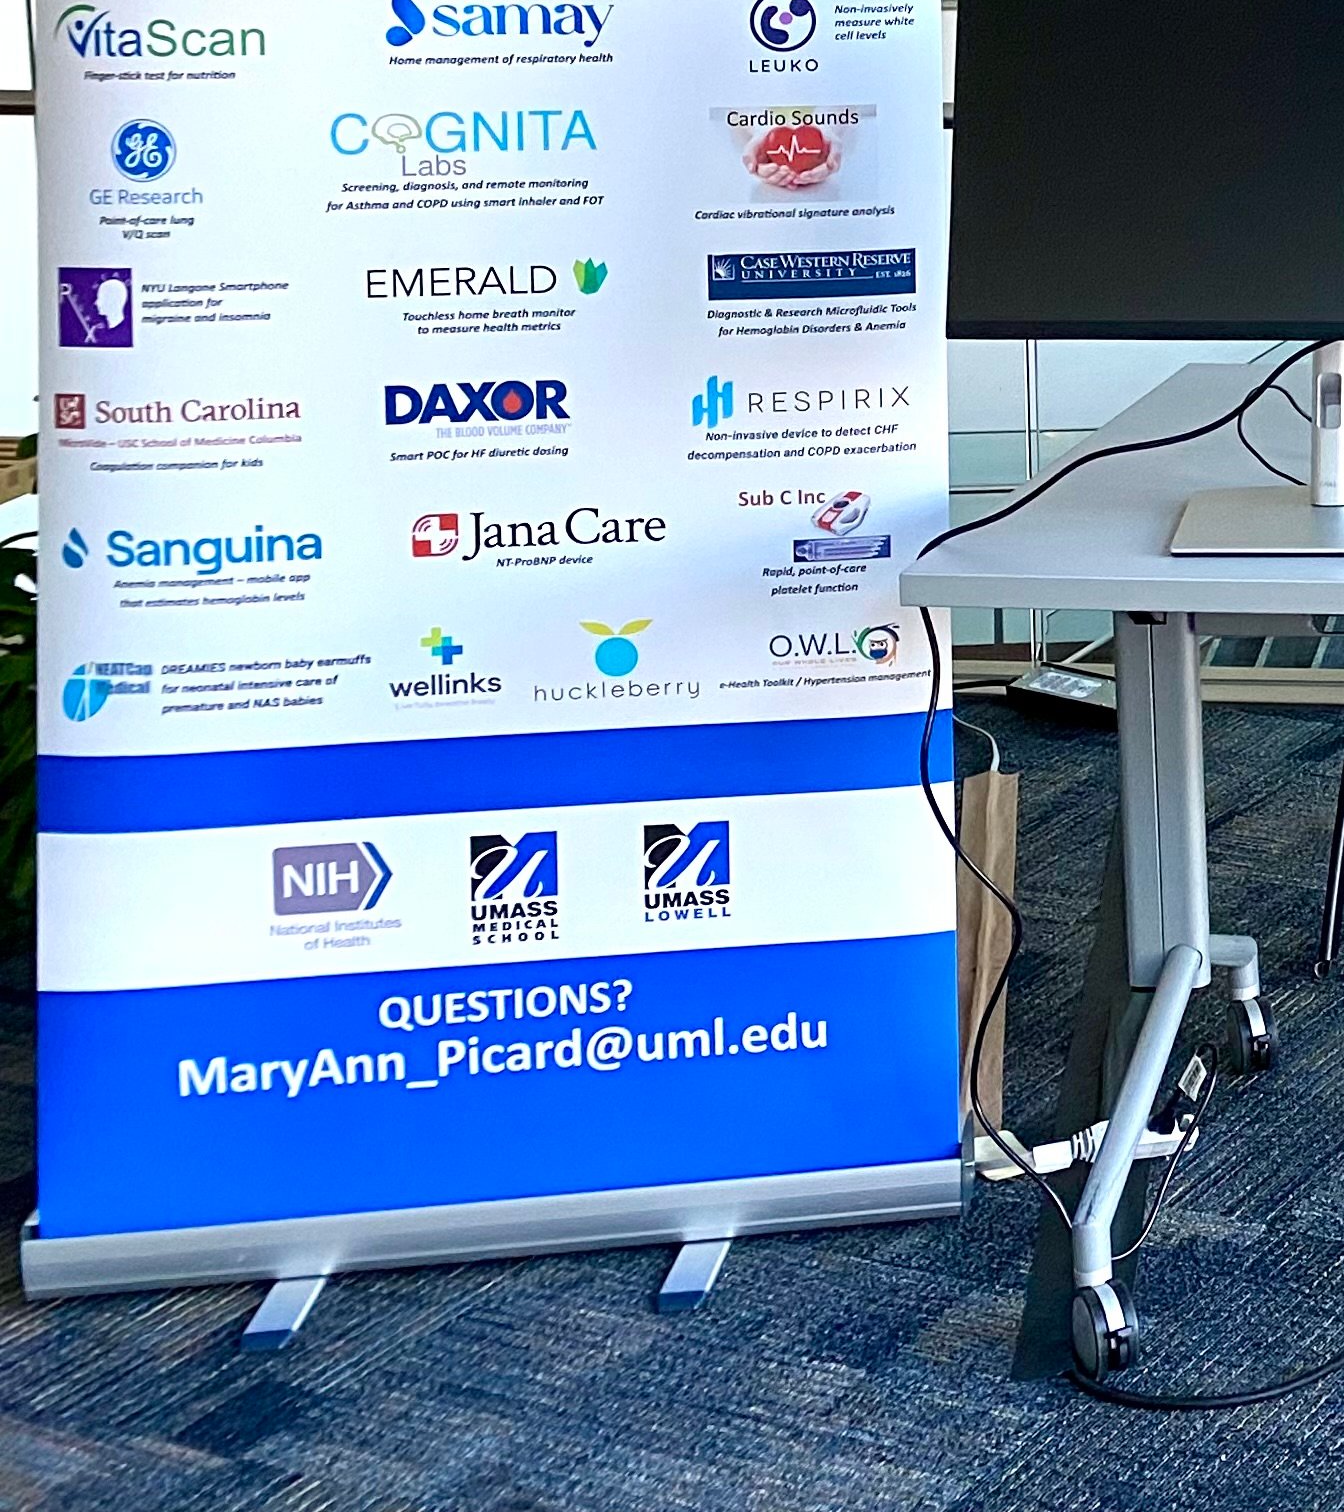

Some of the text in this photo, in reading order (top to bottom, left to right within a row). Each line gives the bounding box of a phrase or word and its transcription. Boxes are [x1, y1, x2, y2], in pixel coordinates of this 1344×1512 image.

[67, 10, 266, 57] VitaScan
[432, 3, 614, 48] samay
[749, 58, 818, 72] LEUKO
[727, 108, 859, 127] Cardio Sounds
[367, 265, 556, 298] EMERALD
[95, 397, 301, 423] South Carolina
[384, 379, 570, 425] DAXOR
[748, 386, 909, 413] RESPIRIX
[738, 489, 825, 506] Sub C Inc
[461, 507, 667, 561] Jana Care
[106, 525, 322, 575] Sanguina
[389, 672, 501, 697] wellinks
[534, 680, 700, 702] huckleberry
[283, 860, 359, 898] NIH
[471, 900, 557, 920] UMASS
[644, 889, 729, 909] UMASS
[269, 917, 402, 936] National Institutes
[472, 918, 558, 932] MEDICAL
[644, 906, 731, 922] LOWELL
[303, 935, 371, 950] of Health
[472, 930, 559, 945] SCHOOL
[378, 979, 632, 1032] QUESTIONS?
[179, 1011, 827, 1098] MaryAnn_Picard@uml.edu
